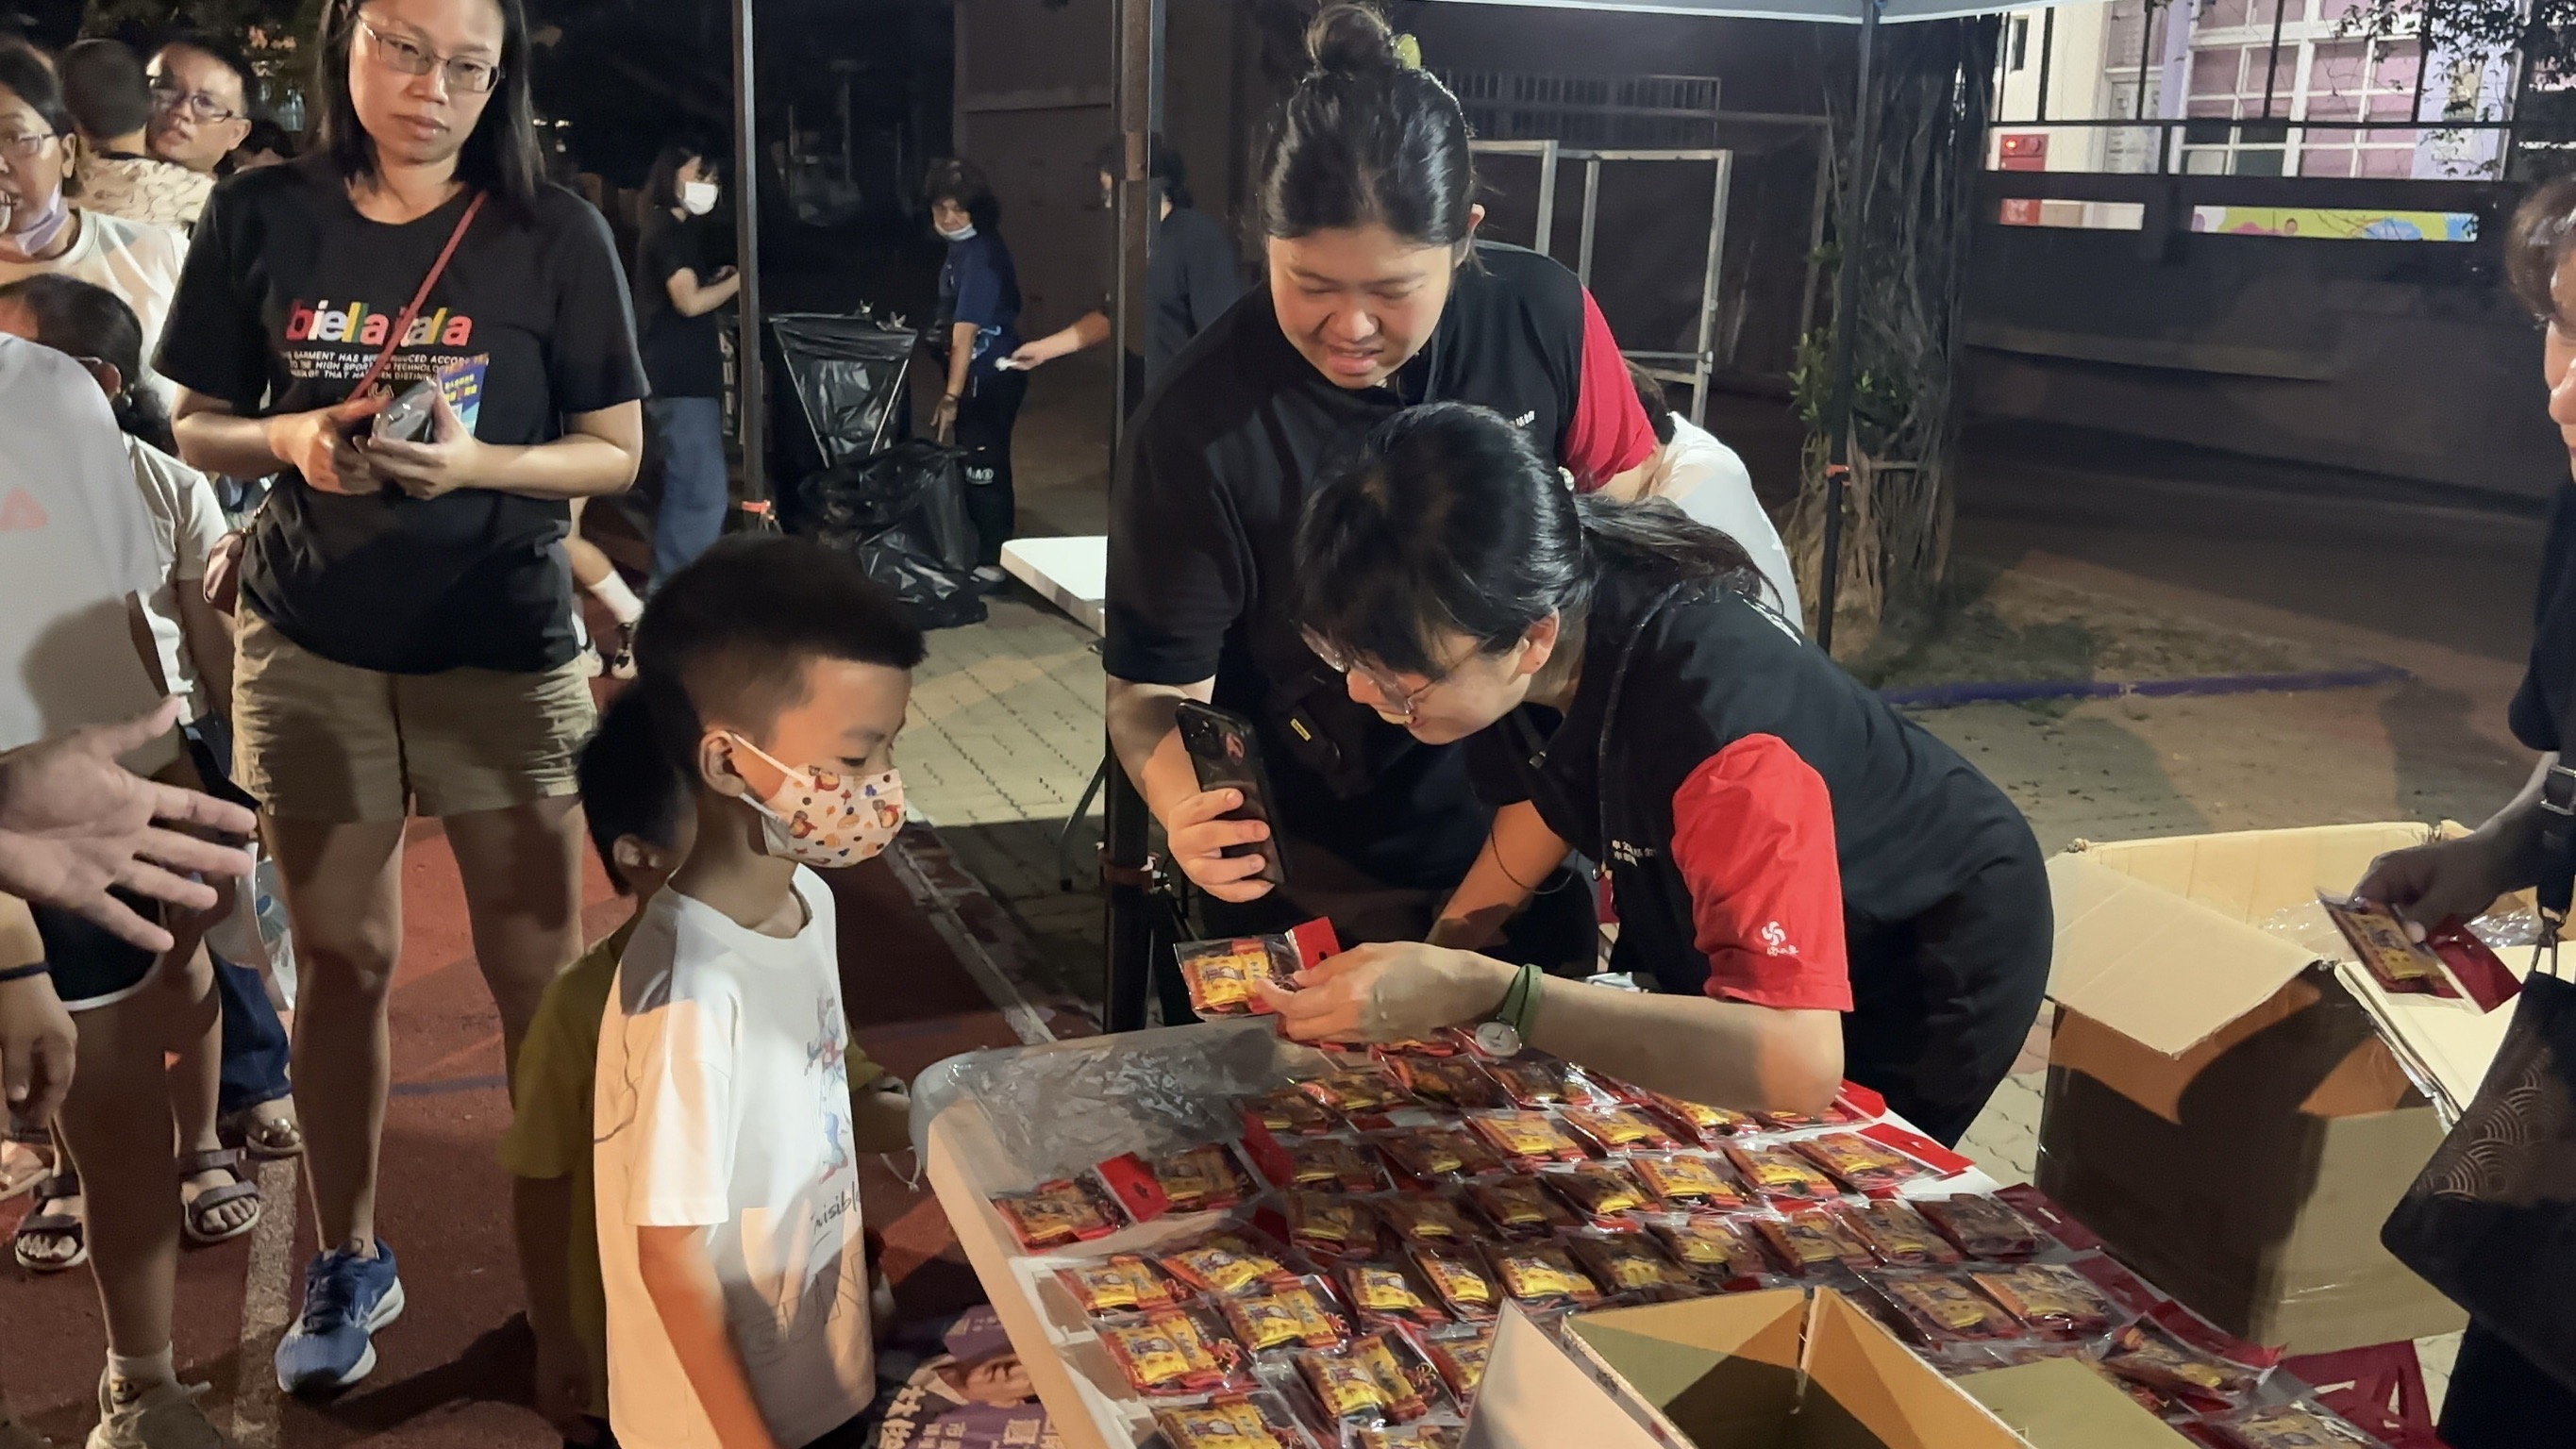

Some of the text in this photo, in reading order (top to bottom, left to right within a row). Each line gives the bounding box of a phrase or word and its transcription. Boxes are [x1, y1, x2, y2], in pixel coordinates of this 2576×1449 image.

[286, 299, 390, 346] biella
[338, 353, 360, 363] HAS
[324, 369, 350, 379] THAT
